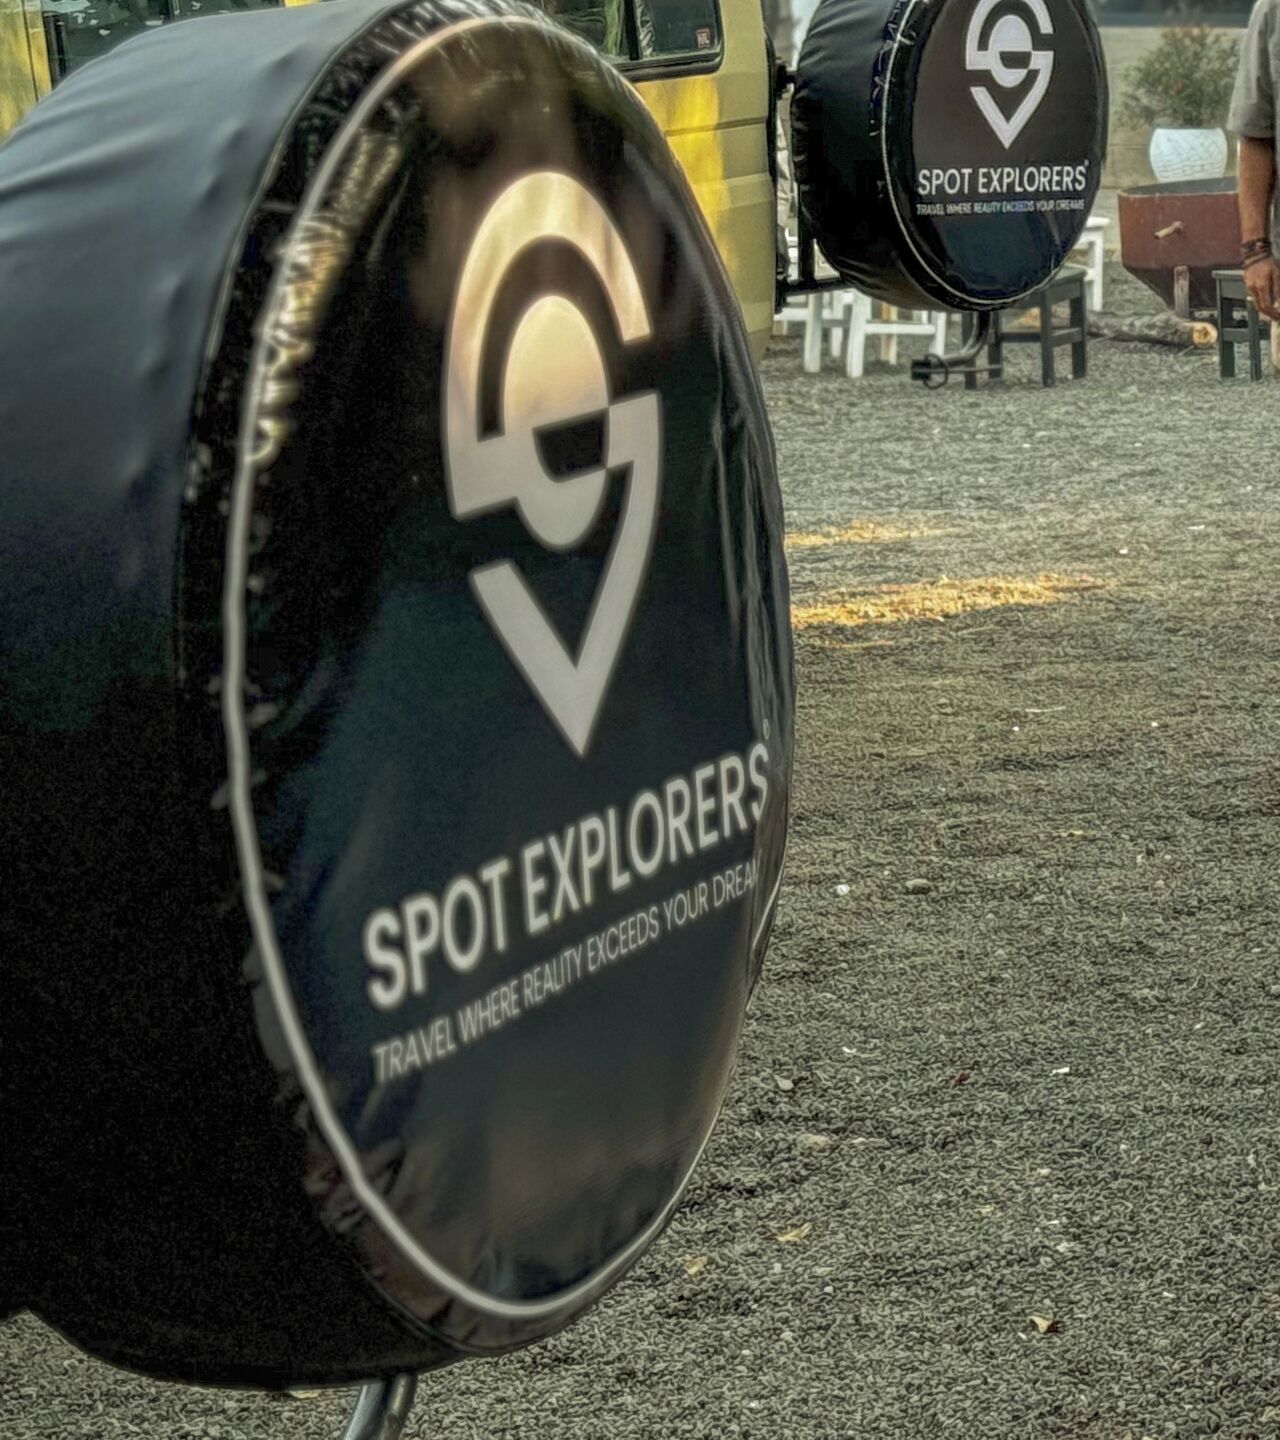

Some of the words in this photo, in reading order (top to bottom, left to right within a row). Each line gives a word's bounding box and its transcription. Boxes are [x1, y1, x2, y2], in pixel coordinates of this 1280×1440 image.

[916, 203, 945, 216] TRAVEL
[946, 202, 971, 215] WHERE
[973, 201, 1001, 214] REALITY
[1036, 199, 1055, 212] YOUR
[917, 168, 972, 196] SPOT
[978, 165, 1087, 194] EXPLORERS
[363, 854, 512, 1011] SPOT
[522, 741, 771, 937] EXPLORERS
[373, 1016, 457, 1084] TRAVEL
[457, 979, 520, 1043] WHERE
[523, 944, 583, 1006] REALITY
[587, 906, 660, 972] EXCEEDS
[663, 883, 709, 931] YOUR
